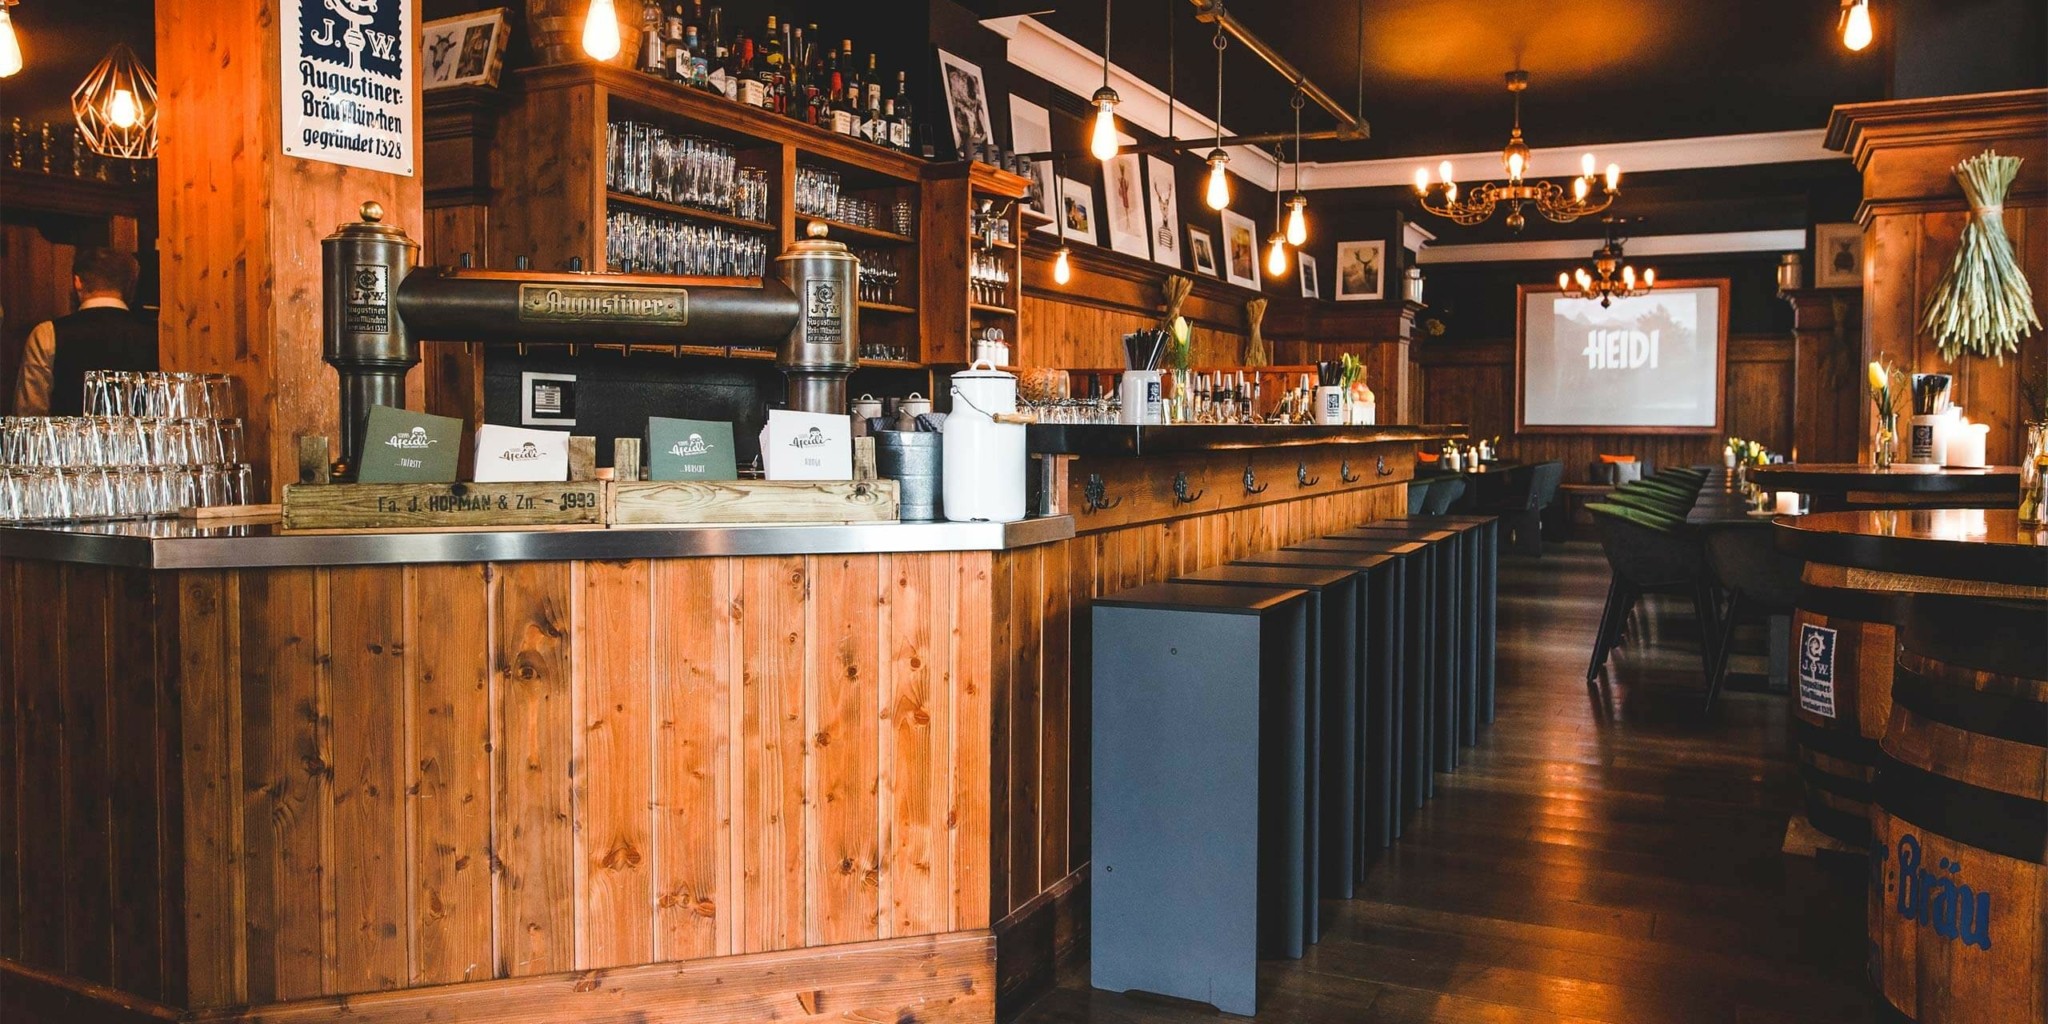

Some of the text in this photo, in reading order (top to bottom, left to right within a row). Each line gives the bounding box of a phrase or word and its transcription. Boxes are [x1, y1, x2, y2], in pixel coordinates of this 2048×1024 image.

[301, 89, 341, 122] Bräu
[302, 127, 402, 160] gegründet 1328
[546, 289, 664, 318] Augustiner
[1581, 328, 1660, 371] HEIDI
[377, 495, 401, 512] Fa.
[408, 496, 422, 512] J.
[429, 494, 491, 513] HOPMAN
[497, 494, 508, 510] &
[516, 494, 537, 510] Zn.
[559, 492, 595, 512] 1993
[1897, 833, 1992, 951] Bräu
